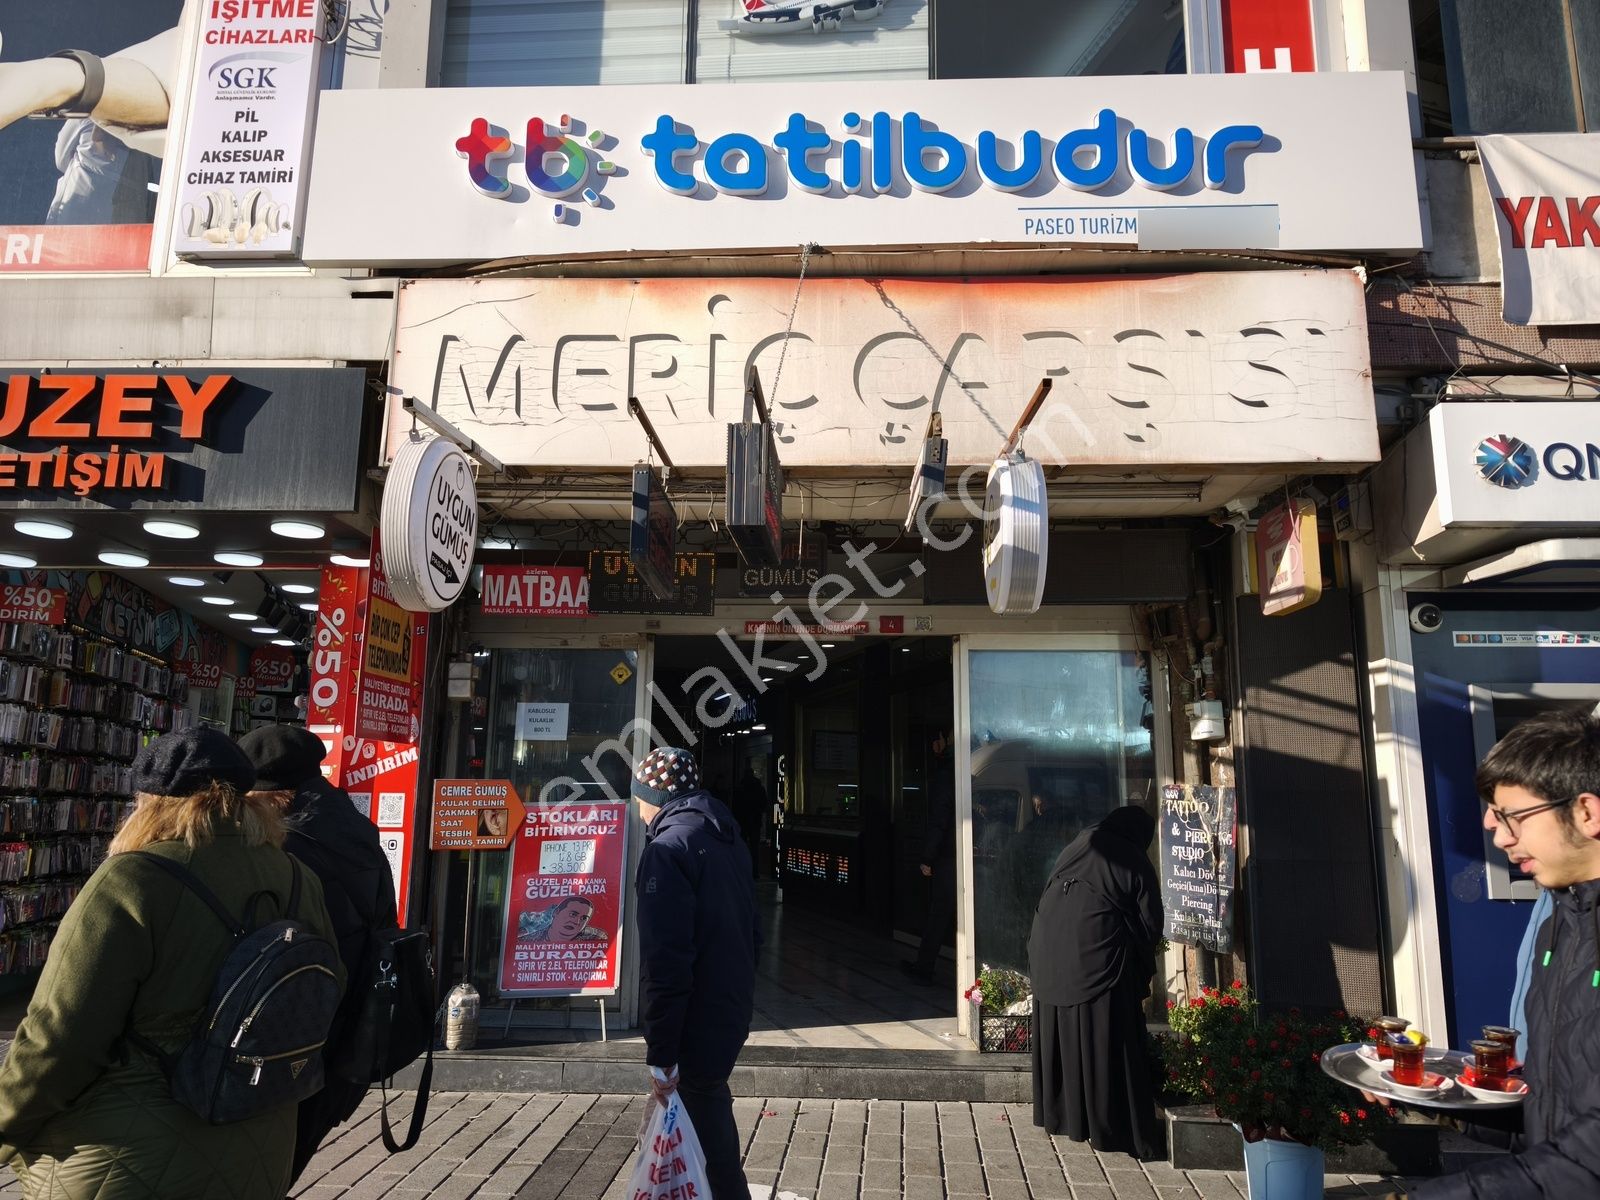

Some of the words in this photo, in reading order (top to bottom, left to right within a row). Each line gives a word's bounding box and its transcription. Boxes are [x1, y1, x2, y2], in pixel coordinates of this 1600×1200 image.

[205, 27, 314, 45] CİHAZLARI
[218, 67, 278, 89] SGK
[234, 107, 259, 123] PİL
[221, 130, 268, 143] KALIP
[200, 149, 285, 163] AKSESUAR
[641, 108, 1264, 197] tatilbudur
[187, 169, 235, 184] CİHAZ
[239, 167, 294, 184] TAMİRİ
[1025, 217, 1075, 235] PASEO
[1080, 213, 1137, 235] TURİZM
[0, 234, 44, 265] RI
[437, 475, 475, 537] UYGUN
[431, 512, 469, 570] GÜMÜŞ
[4, 586, 52, 609] %50
[888, 621, 895, 630] 4
[312, 608, 346, 707] %50
[191, 662, 220, 679] %50
[254, 658, 291, 677] %50
[363, 690, 408, 713] BURADA
[346, 747, 419, 786] İNDİRİM
[440, 785, 473, 797] CEMRE
[472, 799, 505, 807] DELİNİR
[1165, 800, 1209, 816] TATTOO
[438, 809, 477, 817] ÇAKMAK
[526, 810, 618, 824] STOKLARI
[440, 829, 472, 837] TESBİH
[524, 823, 617, 837] BİTİRİYORUZ
[1171, 822, 1181, 836] &
[575, 852, 587, 861] GB
[1171, 845, 1205, 864] STUDIO
[549, 862, 586, 873] 38.500
[1173, 864, 1196, 878] Kalıcı
[562, 878, 583, 886] PARA
[578, 884, 606, 895] PARA
[1181, 894, 1213, 914] Piercing
[1173, 909, 1197, 923] Kulak
[1170, 922, 1191, 939] Pasaj
[515, 943, 566, 951] MALİYETİNE
[568, 942, 608, 951] SATIŞLAR
[514, 950, 607, 960] BURADA
[517, 961, 536, 971] SIFIR
[537, 961, 546, 970] VE
[547, 961, 563, 970] 2.EL
[565, 960, 608, 970] TELEFONLAR
[516, 973, 544, 982] SINIRLI
[546, 972, 566, 981] STOK
[573, 971, 607, 983] KAÇIRMA
